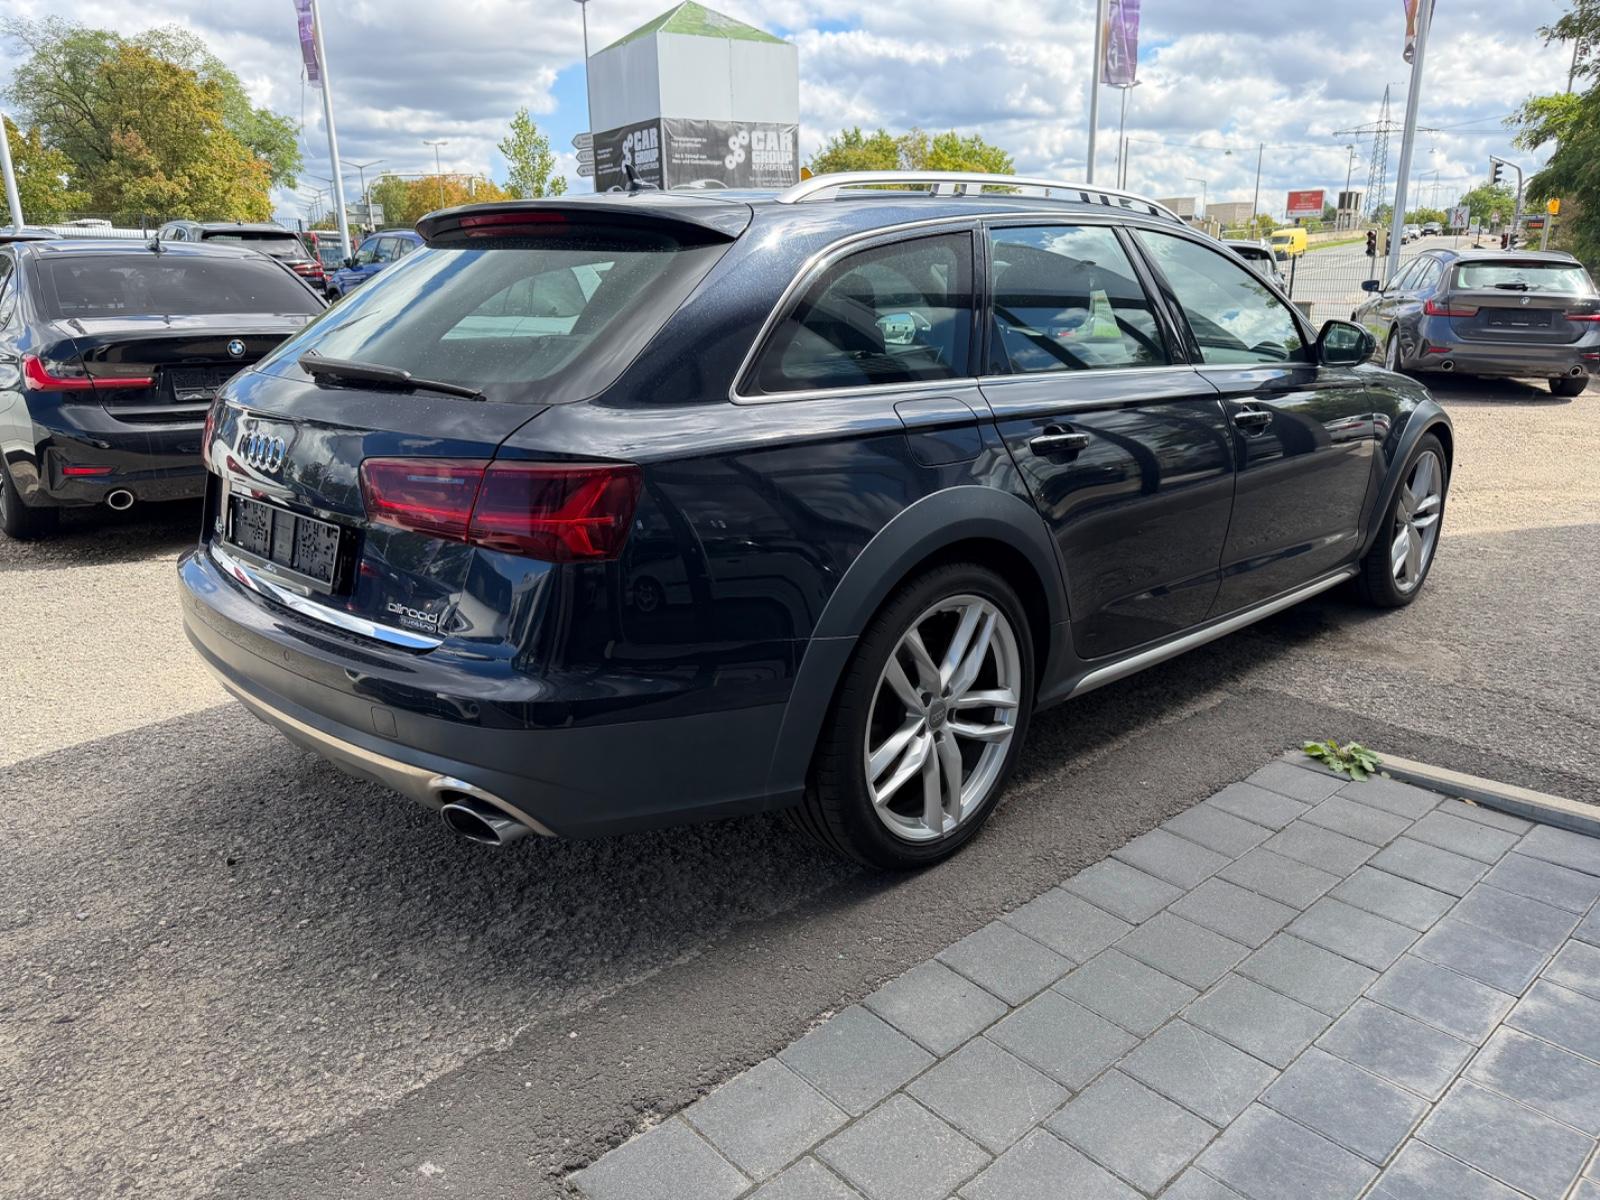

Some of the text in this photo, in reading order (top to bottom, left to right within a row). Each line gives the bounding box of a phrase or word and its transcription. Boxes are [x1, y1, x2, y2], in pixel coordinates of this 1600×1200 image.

[634, 128, 658, 150] CAR
[751, 131, 793, 151] CAR
[634, 148, 659, 165] GROUP
[751, 150, 793, 164] GROUP
[387, 602, 438, 624] allroad
